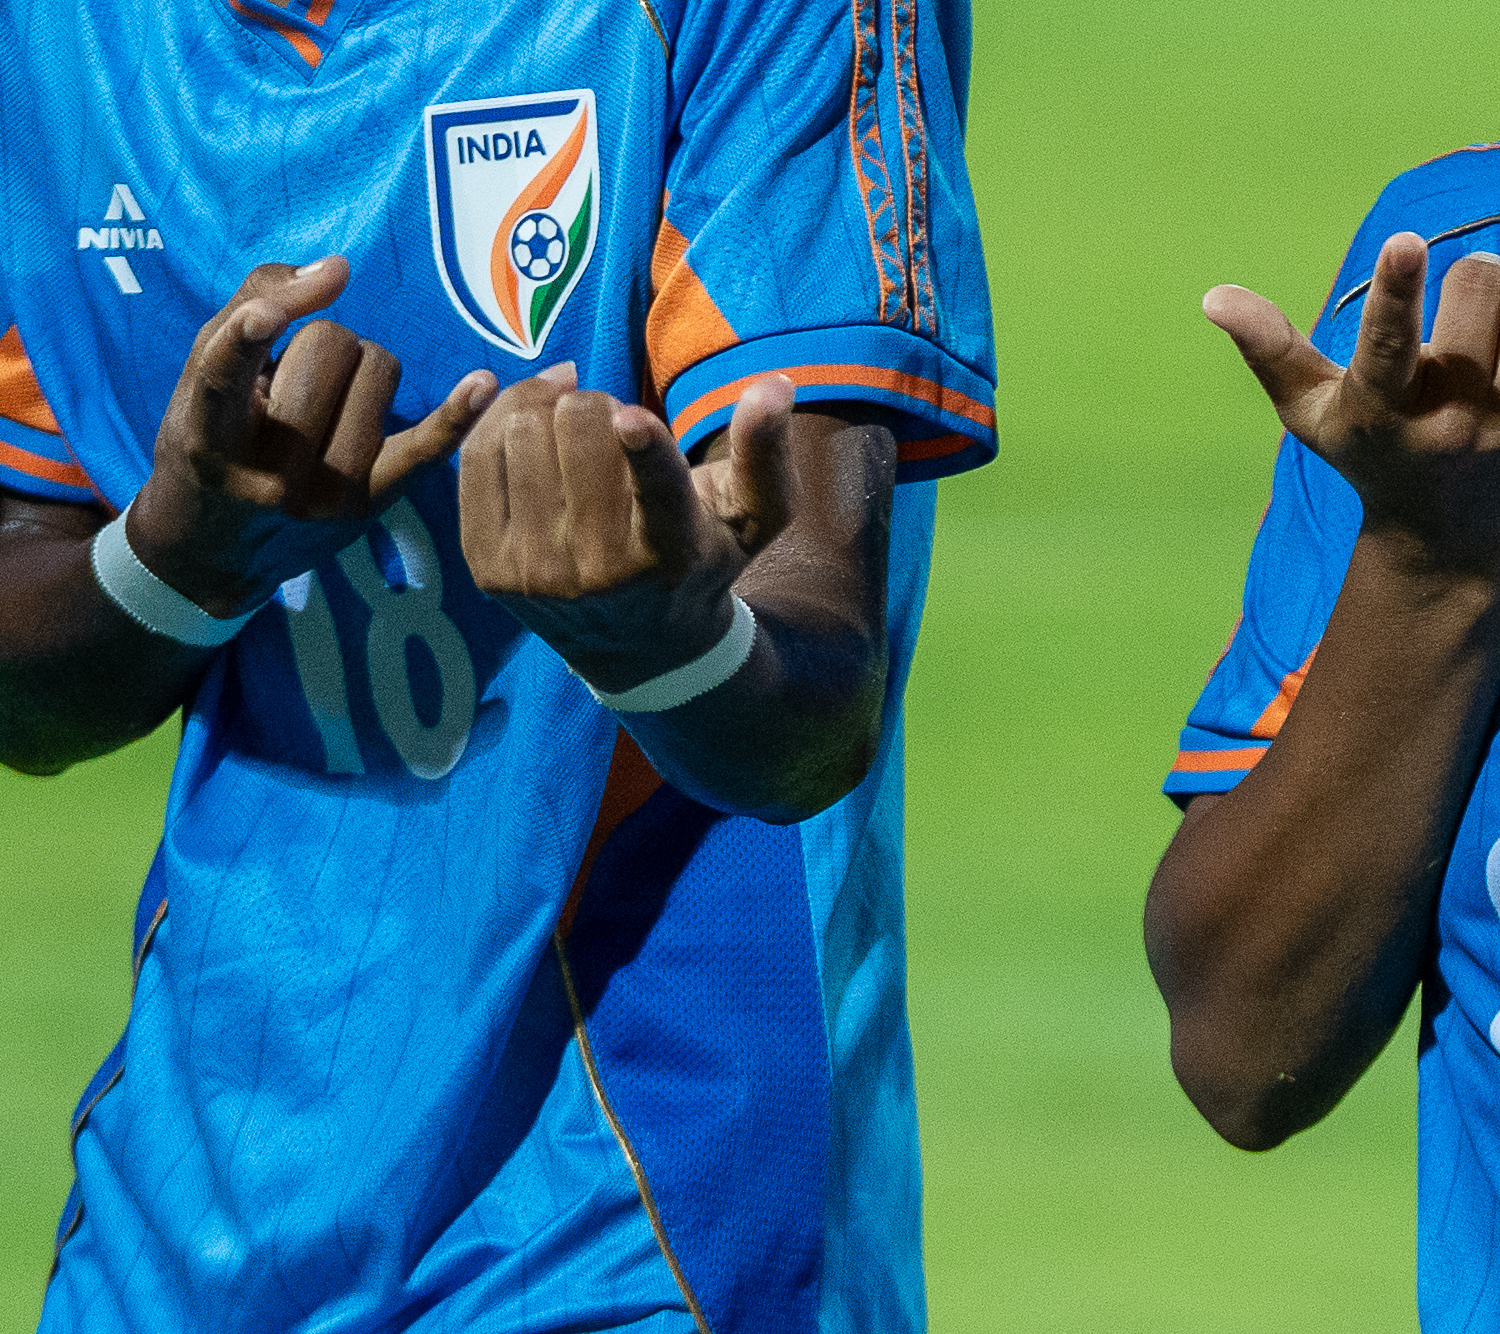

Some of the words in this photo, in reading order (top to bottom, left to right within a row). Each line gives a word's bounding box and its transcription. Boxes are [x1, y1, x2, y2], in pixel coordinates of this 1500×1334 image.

[457, 128, 546, 165] INDIA
[78, 227, 164, 249] NIVIA
[278, 494, 477, 781] 18
